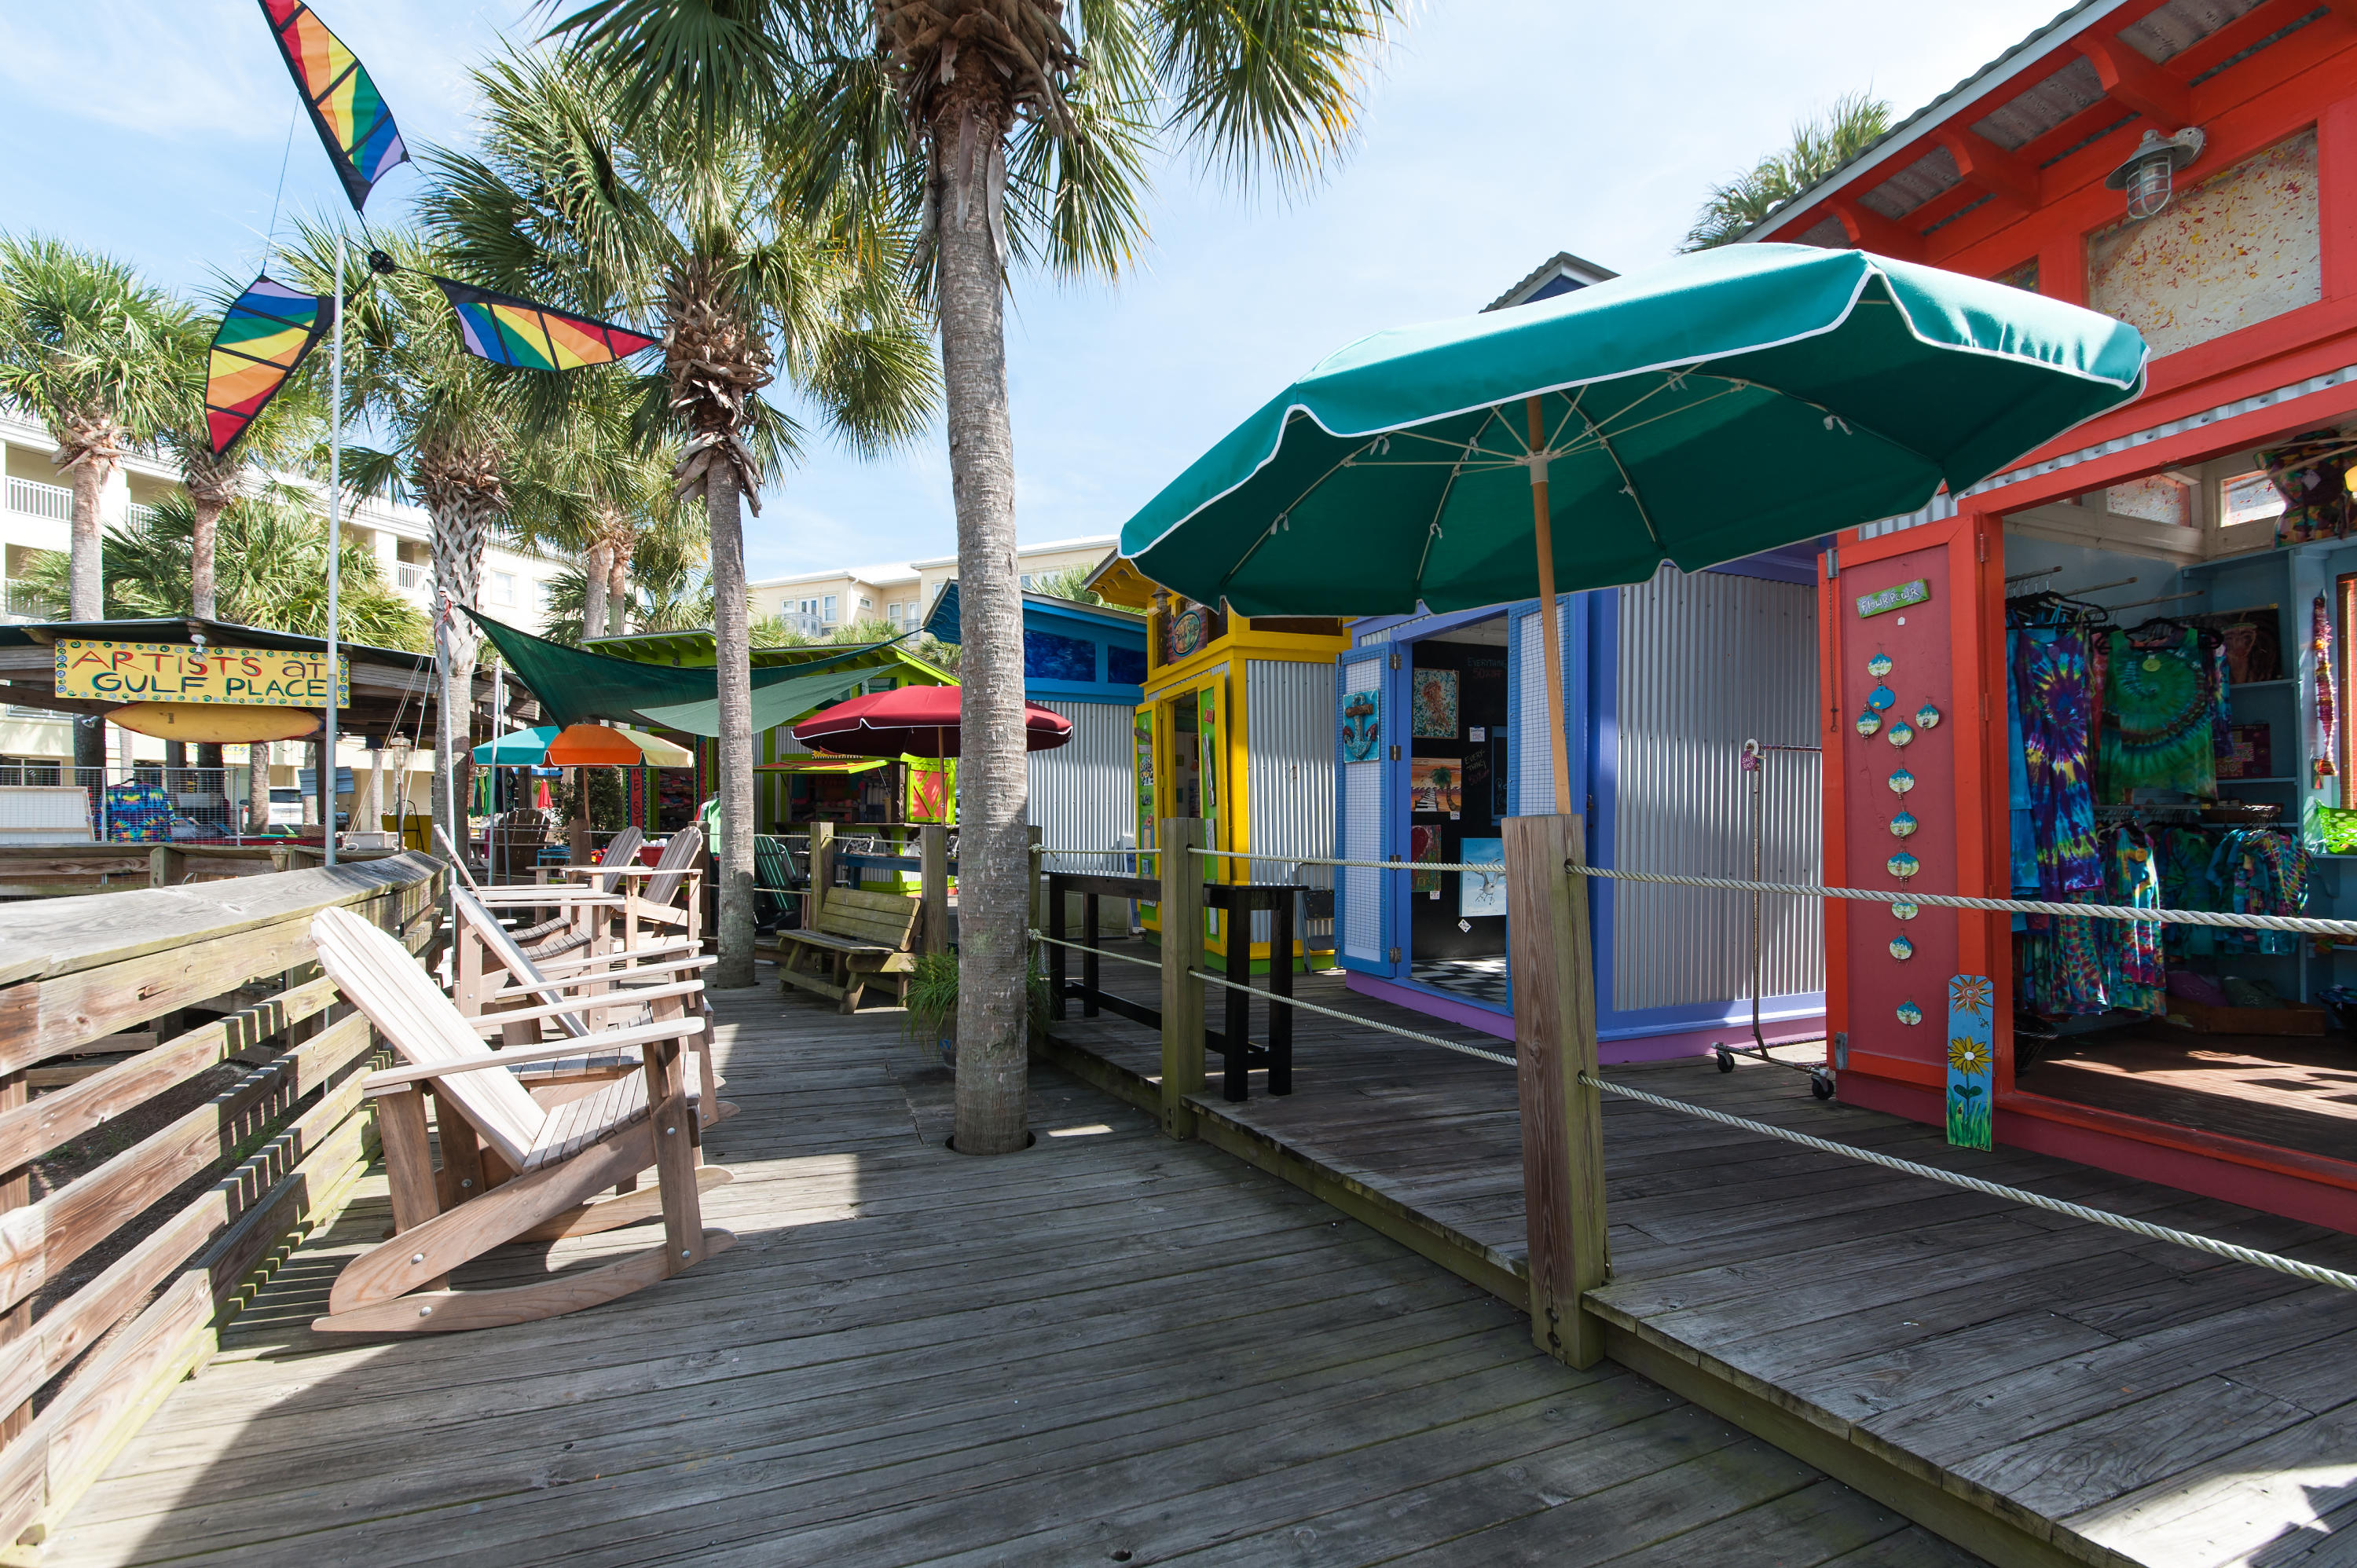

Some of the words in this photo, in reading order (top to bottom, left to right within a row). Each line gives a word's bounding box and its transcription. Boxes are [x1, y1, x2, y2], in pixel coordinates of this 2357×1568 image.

[71, 650, 262, 677] ARTISTS
[91, 672, 209, 694] GULF
[225, 676, 328, 698] PLACE
